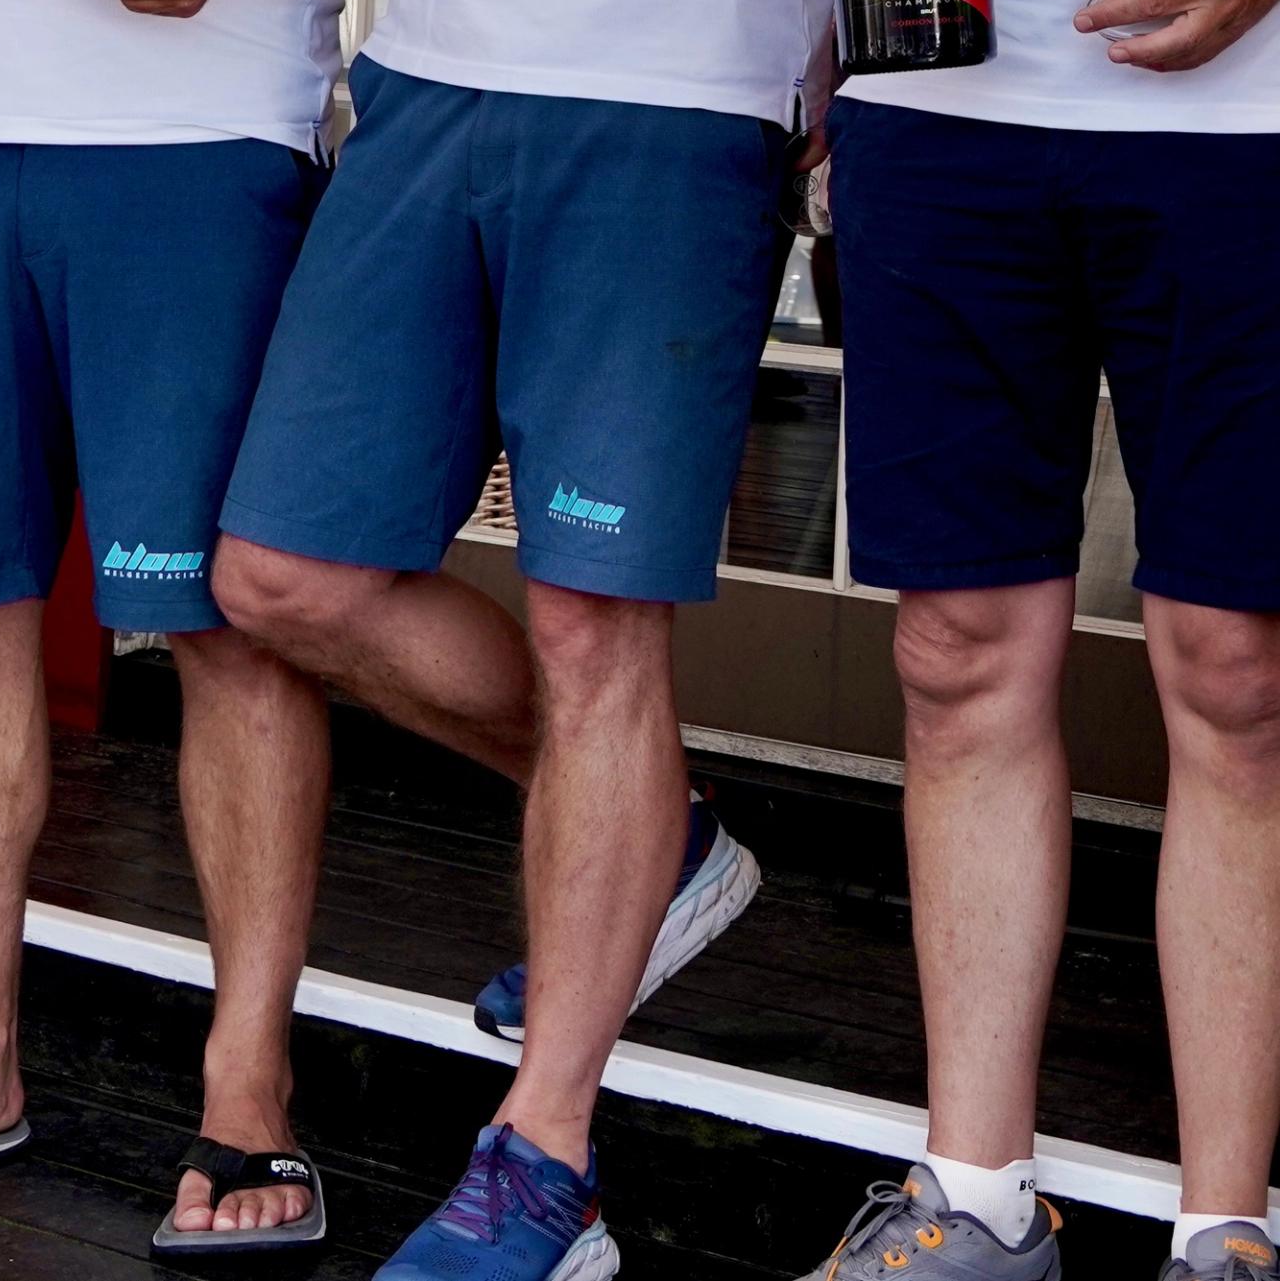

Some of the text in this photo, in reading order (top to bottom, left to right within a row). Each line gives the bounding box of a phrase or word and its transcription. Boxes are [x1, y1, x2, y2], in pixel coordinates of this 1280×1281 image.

[582, 520, 621, 535] RACING
[104, 568, 204, 580] MELGES RACING
